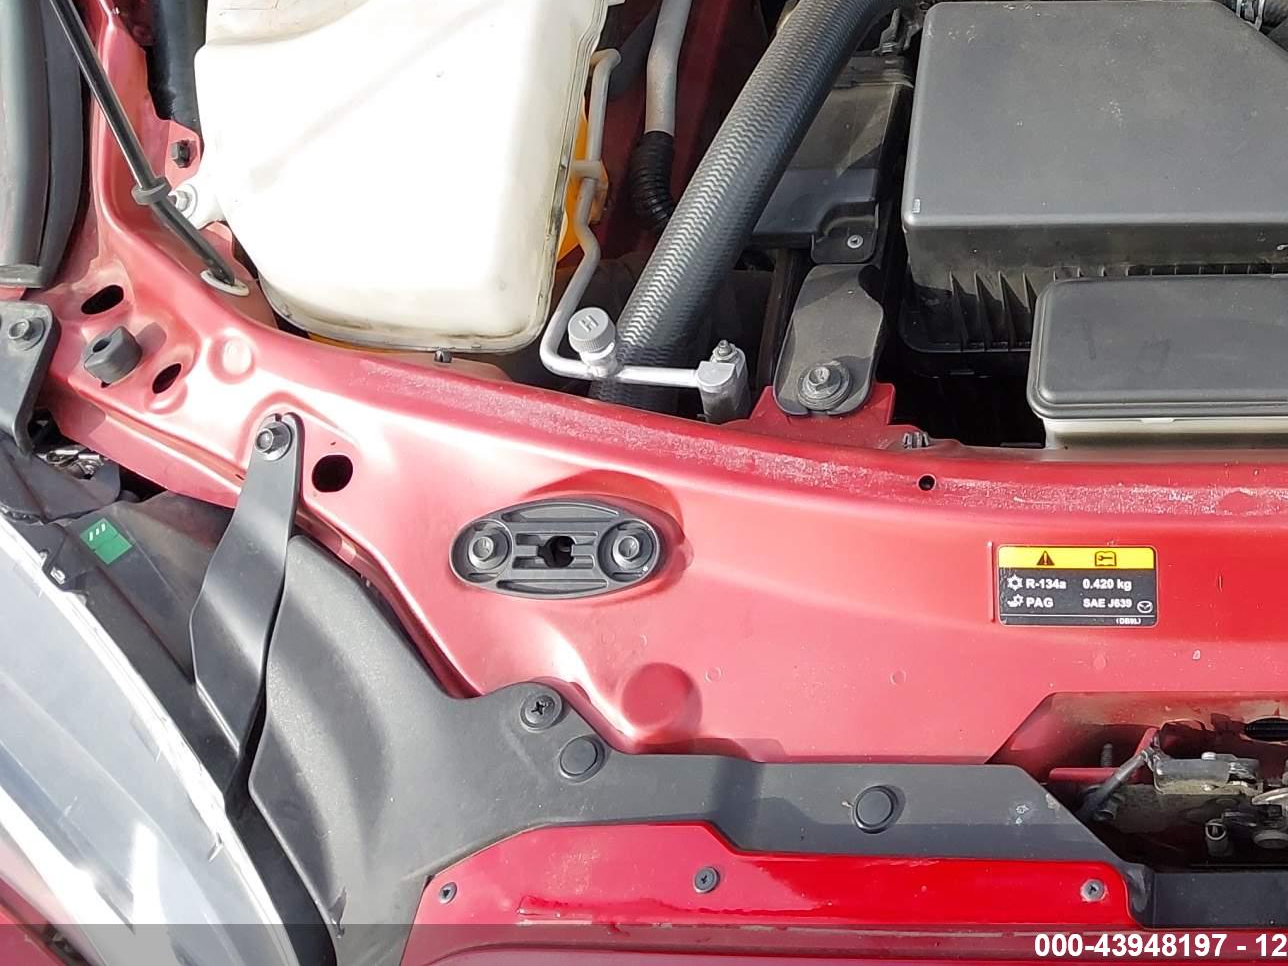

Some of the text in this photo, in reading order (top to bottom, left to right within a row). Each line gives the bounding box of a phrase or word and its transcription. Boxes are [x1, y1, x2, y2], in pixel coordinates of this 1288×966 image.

[1026, 579, 1132, 590] R-134a 0.420 kg
[1026, 598, 1132, 608] PAG SAE J639
